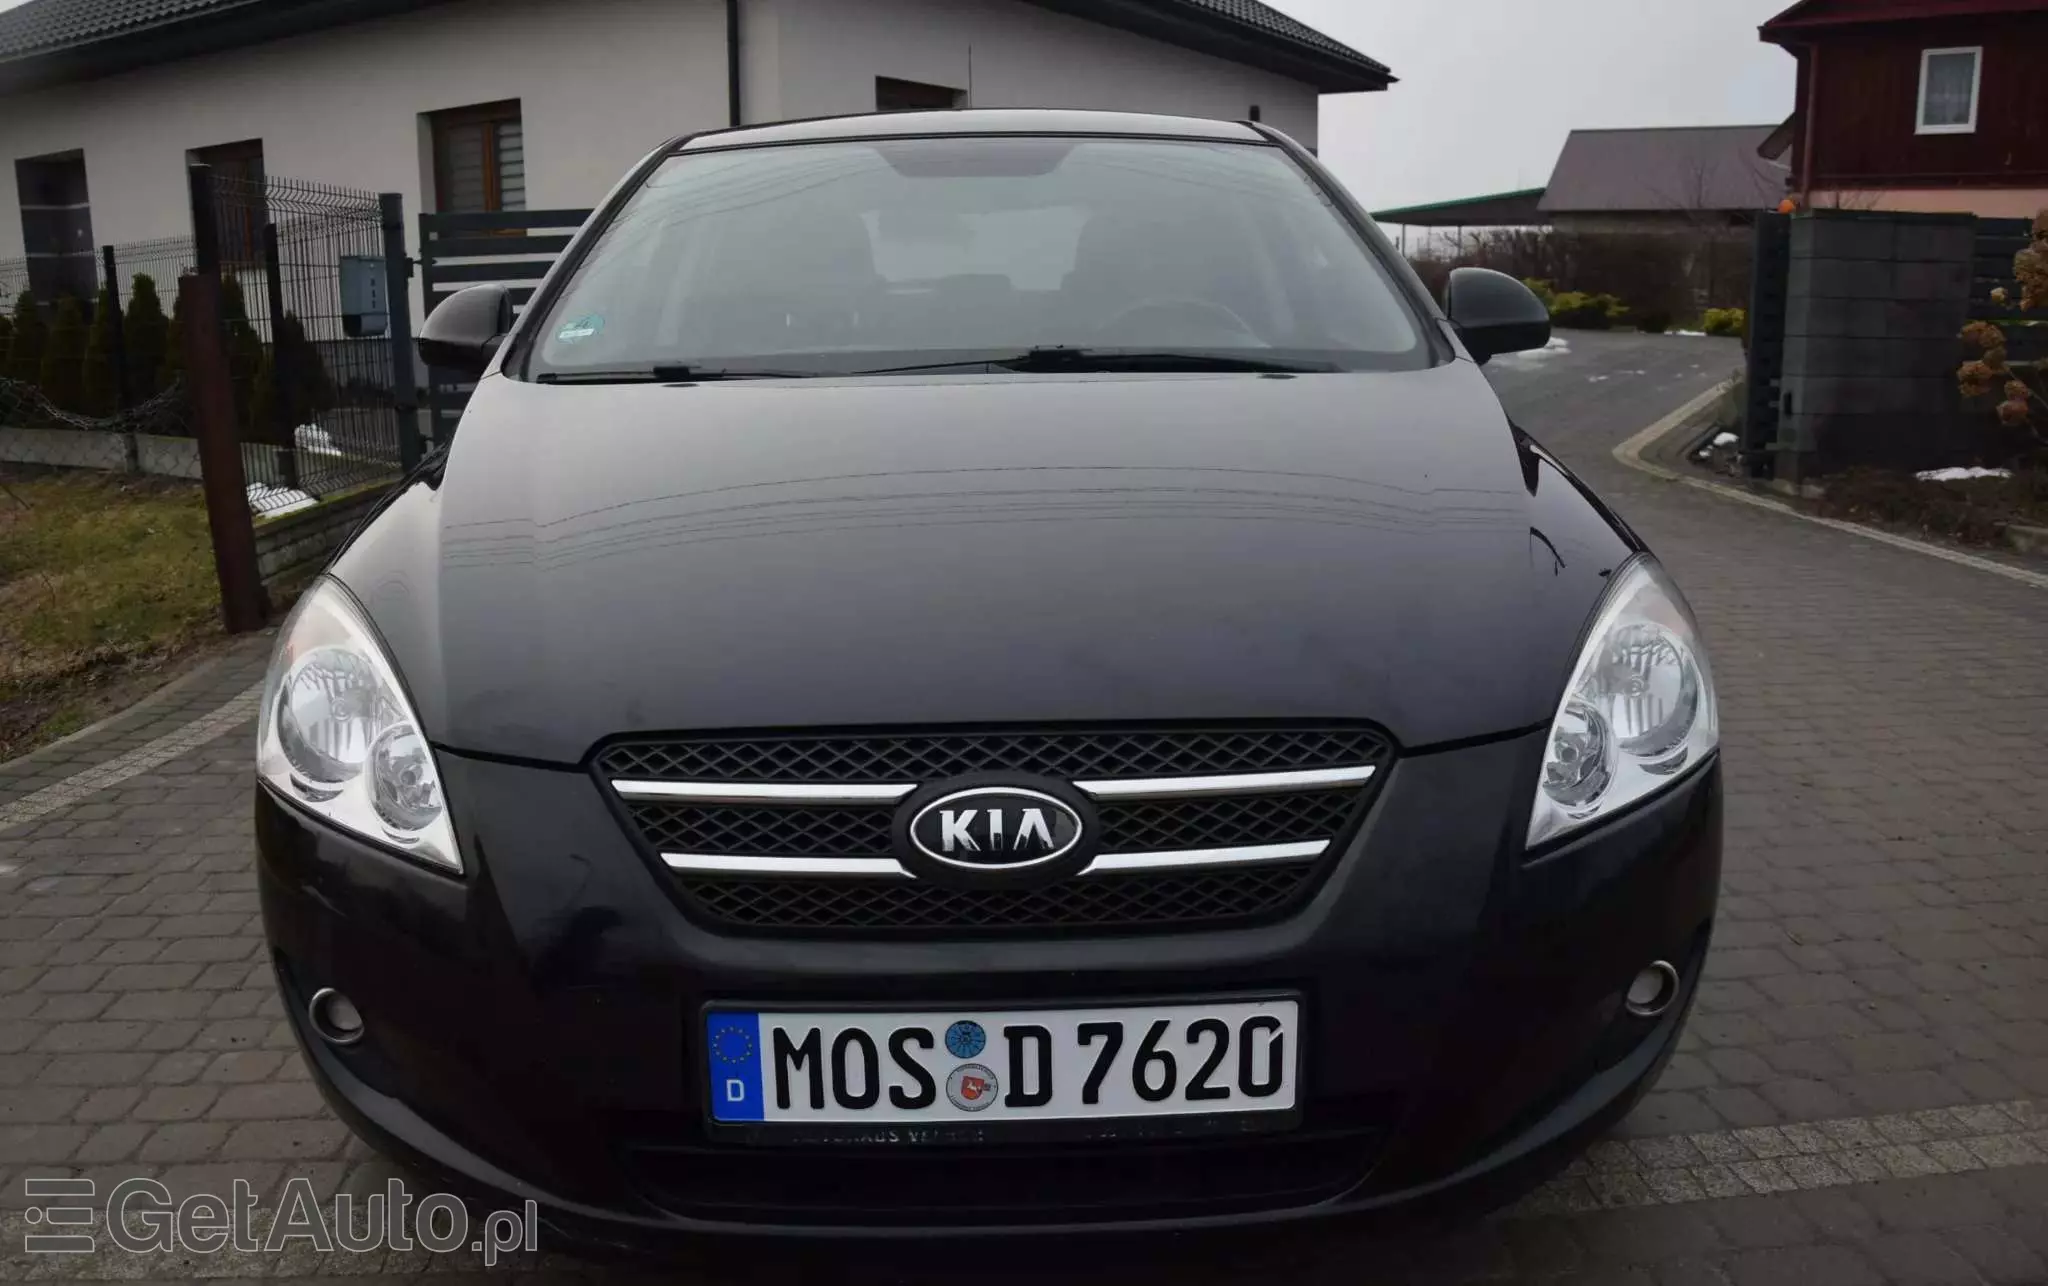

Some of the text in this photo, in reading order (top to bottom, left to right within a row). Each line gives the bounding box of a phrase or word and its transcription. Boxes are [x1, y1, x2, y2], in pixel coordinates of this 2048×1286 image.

[939, 808, 1054, 851] KIA
[773, 1016, 1283, 1110] MOS D 7620
[727, 1080, 745, 1102] D
